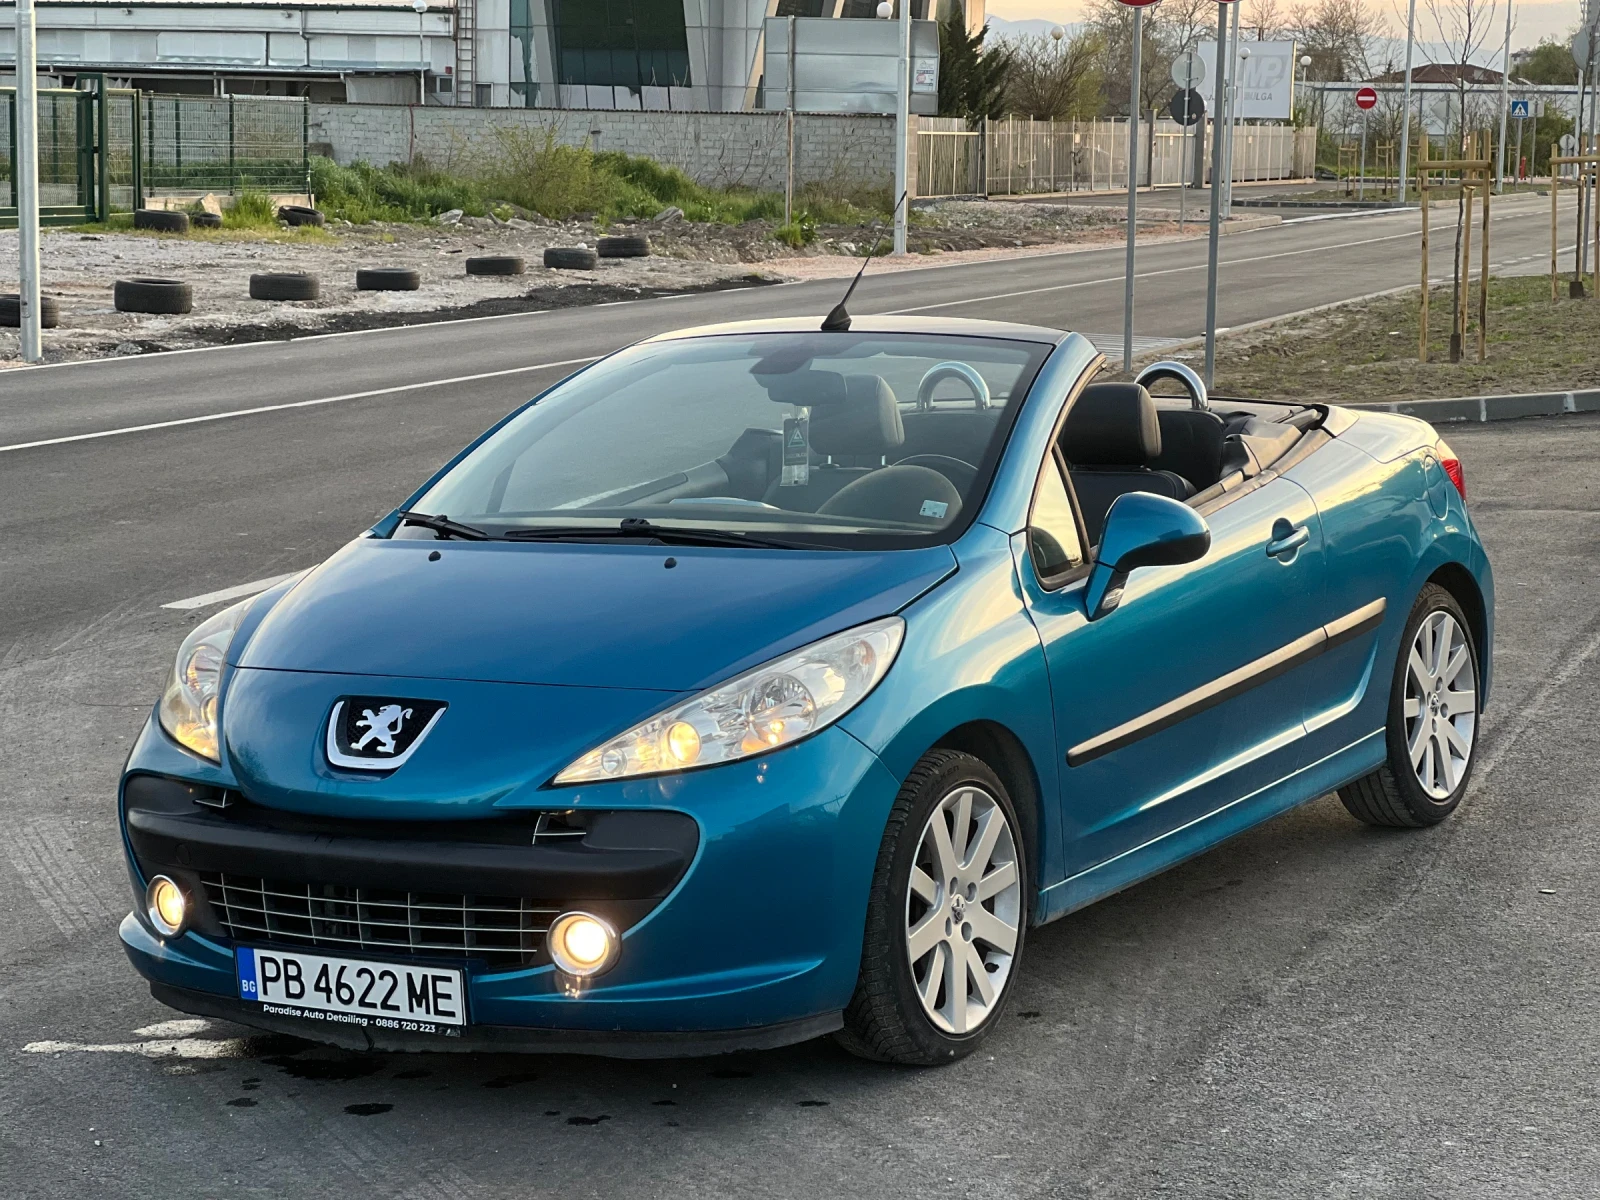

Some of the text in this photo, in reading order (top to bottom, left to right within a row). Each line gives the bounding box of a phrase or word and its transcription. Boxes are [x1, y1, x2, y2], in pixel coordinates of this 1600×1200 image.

[242, 979, 256, 993] BG
[259, 955, 456, 1018] PB 4622 ME
[263, 1004, 302, 1018] Paradise
[303, 1009, 325, 1021] Auto
[326, 1011, 368, 1027] Detailing
[375, 1017, 399, 1030] 0886
[401, 1020, 418, 1032] 720
[419, 1022, 436, 1034] 223
